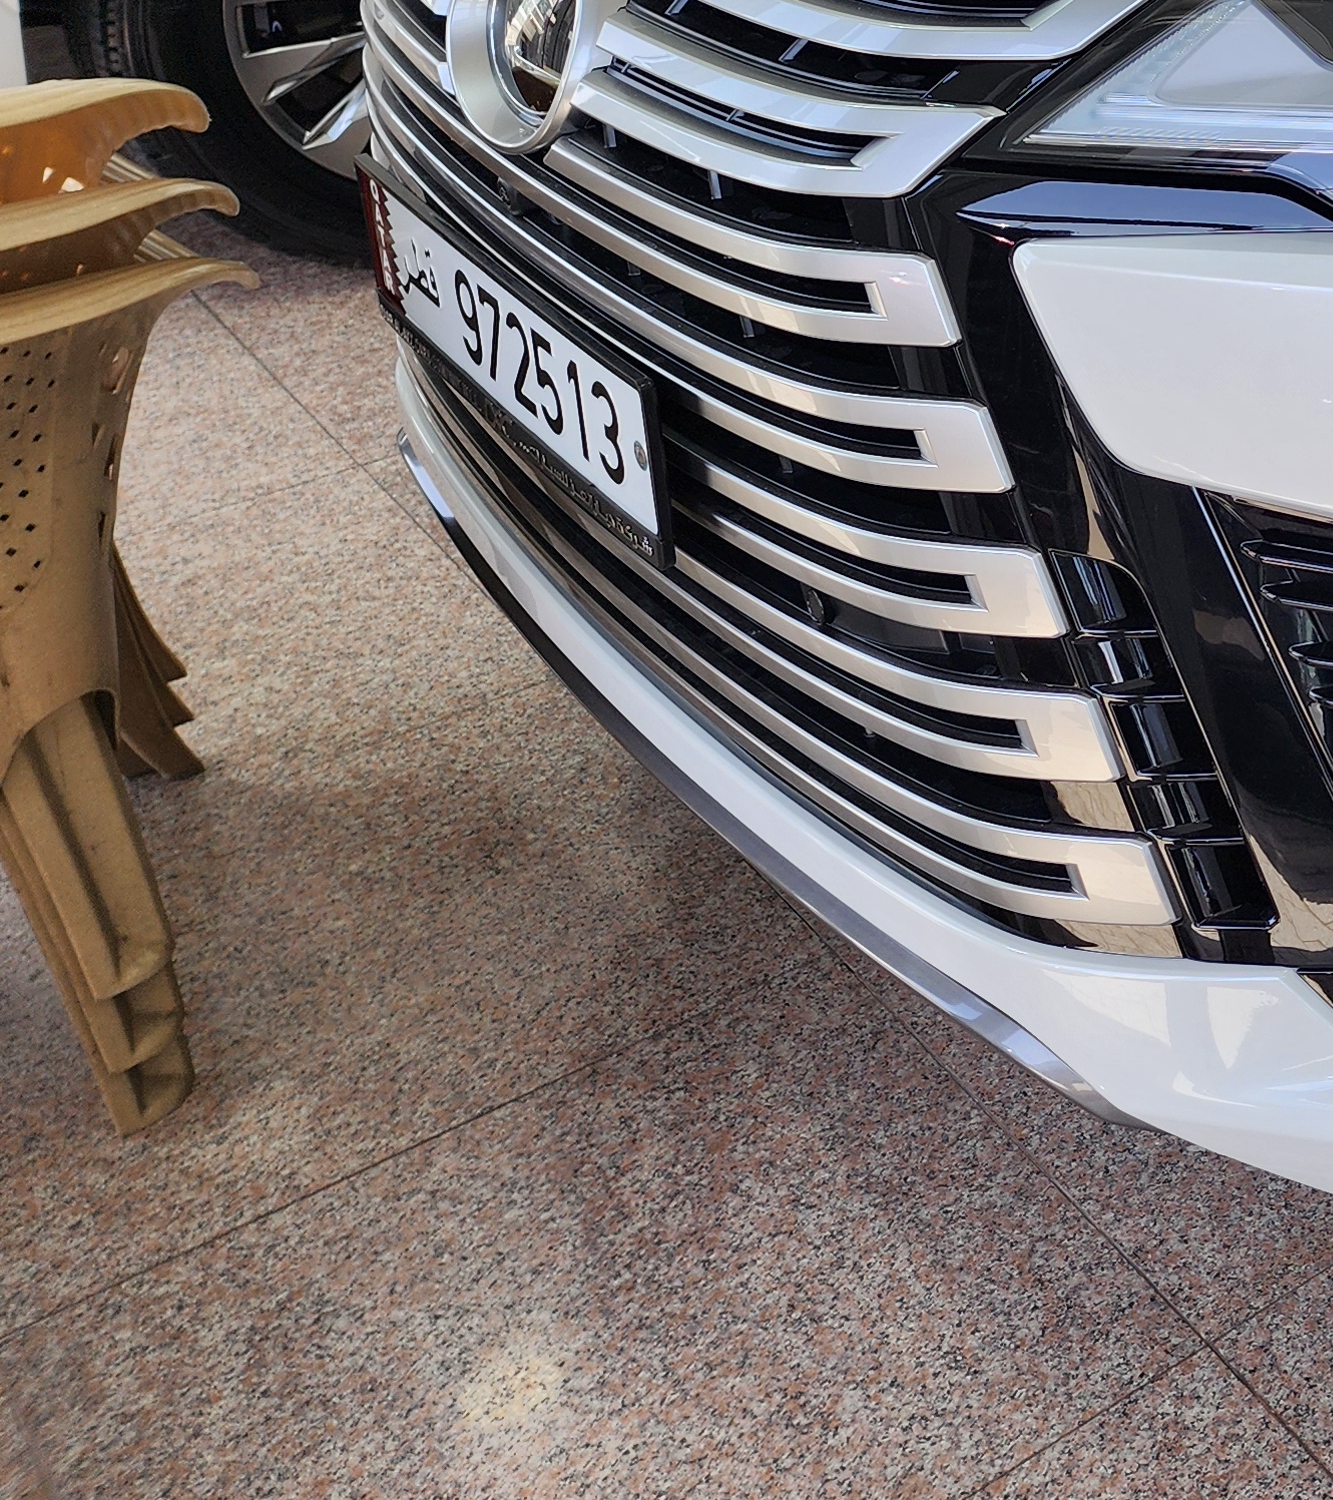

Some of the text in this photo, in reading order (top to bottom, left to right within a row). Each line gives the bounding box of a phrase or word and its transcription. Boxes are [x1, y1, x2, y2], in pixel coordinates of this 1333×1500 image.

[370, 179, 396, 296] QATAR
[400, 237, 441, 308] قطر
[454, 269, 626, 485] 972513
[613, 512, 654, 557] شركة
